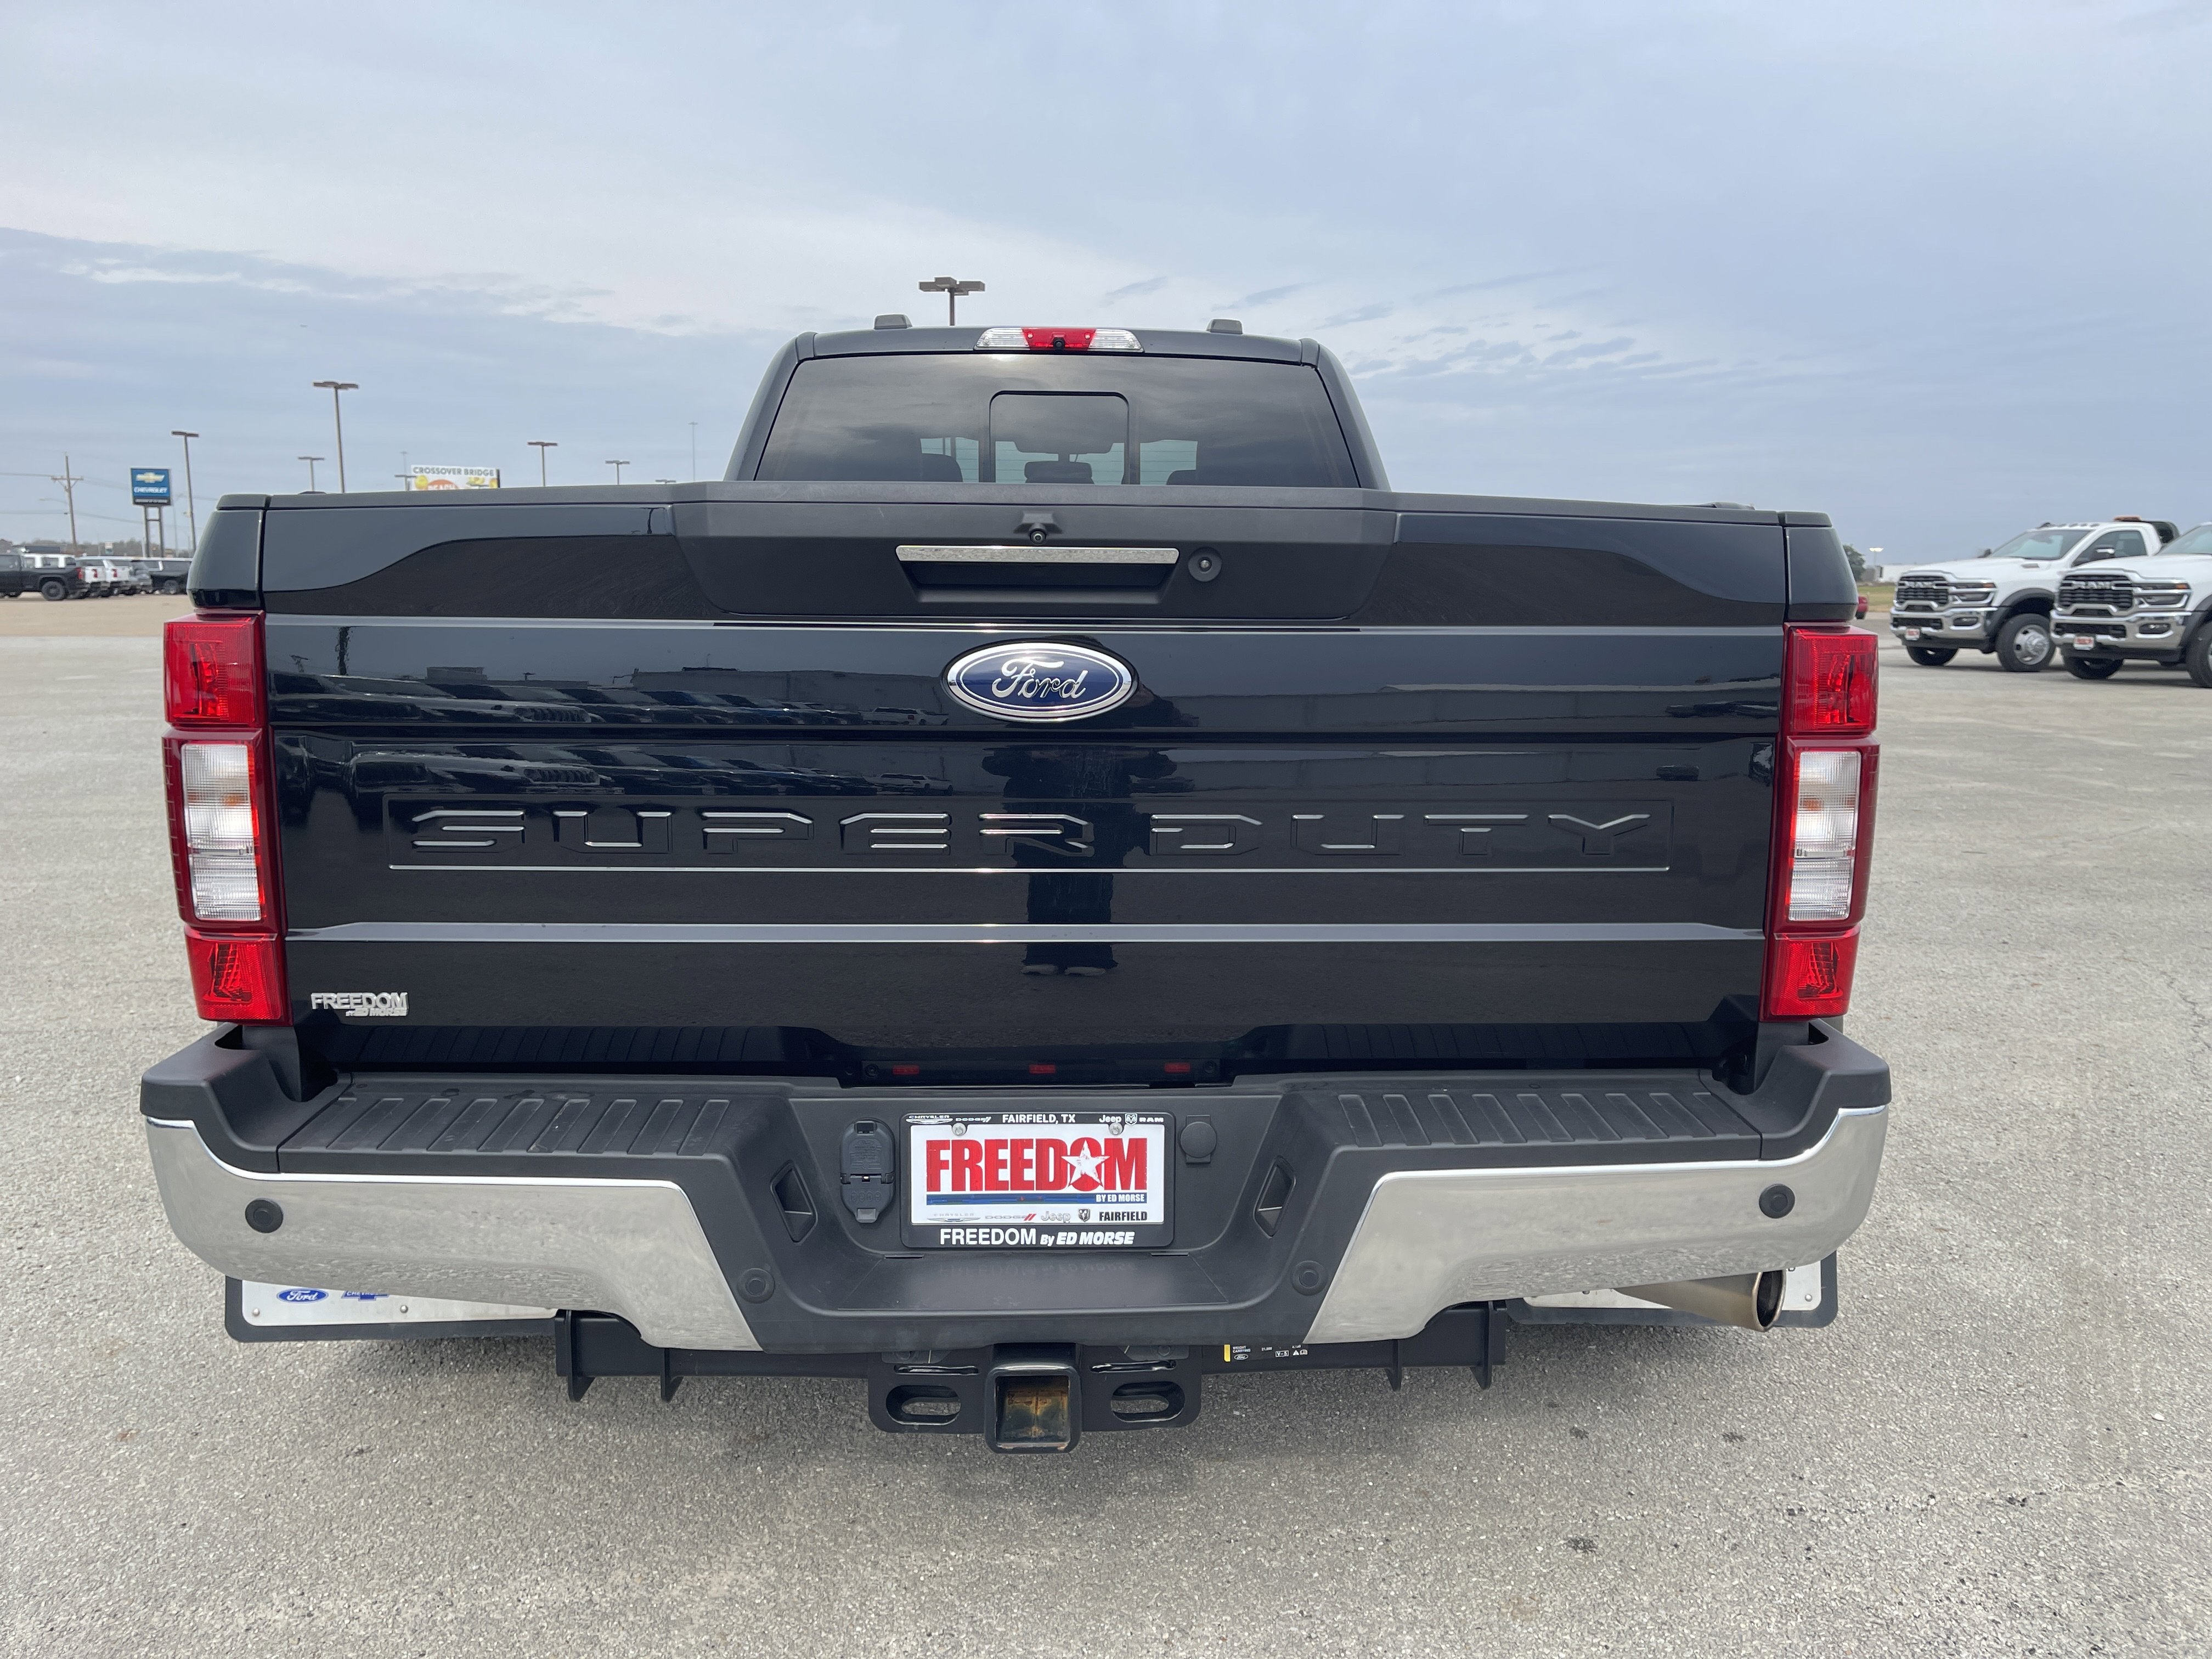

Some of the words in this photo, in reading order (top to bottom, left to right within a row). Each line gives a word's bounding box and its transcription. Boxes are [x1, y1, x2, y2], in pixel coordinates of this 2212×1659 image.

[464, 468, 494, 476] BRIDGE
[992, 657, 1088, 698] Ford
[410, 809, 1096, 857] SUPER
[1149, 814, 1651, 856] DUTY
[311, 992, 409, 1009] FREEDOM
[369, 1008, 408, 1017] MORSE
[1002, 1114, 1059, 1124] FAIRFIELD,
[1061, 1114, 1076, 1123] TX
[1099, 1115, 1122, 1123] Jeep
[926, 1137, 1148, 1192] FREEDOM
[1096, 1194, 1105, 1203] BY
[1107, 1194, 1117, 1203] ED
[1118, 1194, 1145, 1202] MORSE
[1041, 1211, 1071, 1223] Jeep
[1099, 1211, 1148, 1222] FAIRFIELD
[940, 1228, 1036, 1245] FREEDOM
[1040, 1232, 1054, 1246] By
[1056, 1232, 1077, 1245] ED
[1079, 1232, 1135, 1245] MORSE
[287, 1290, 319, 1301] Ford
